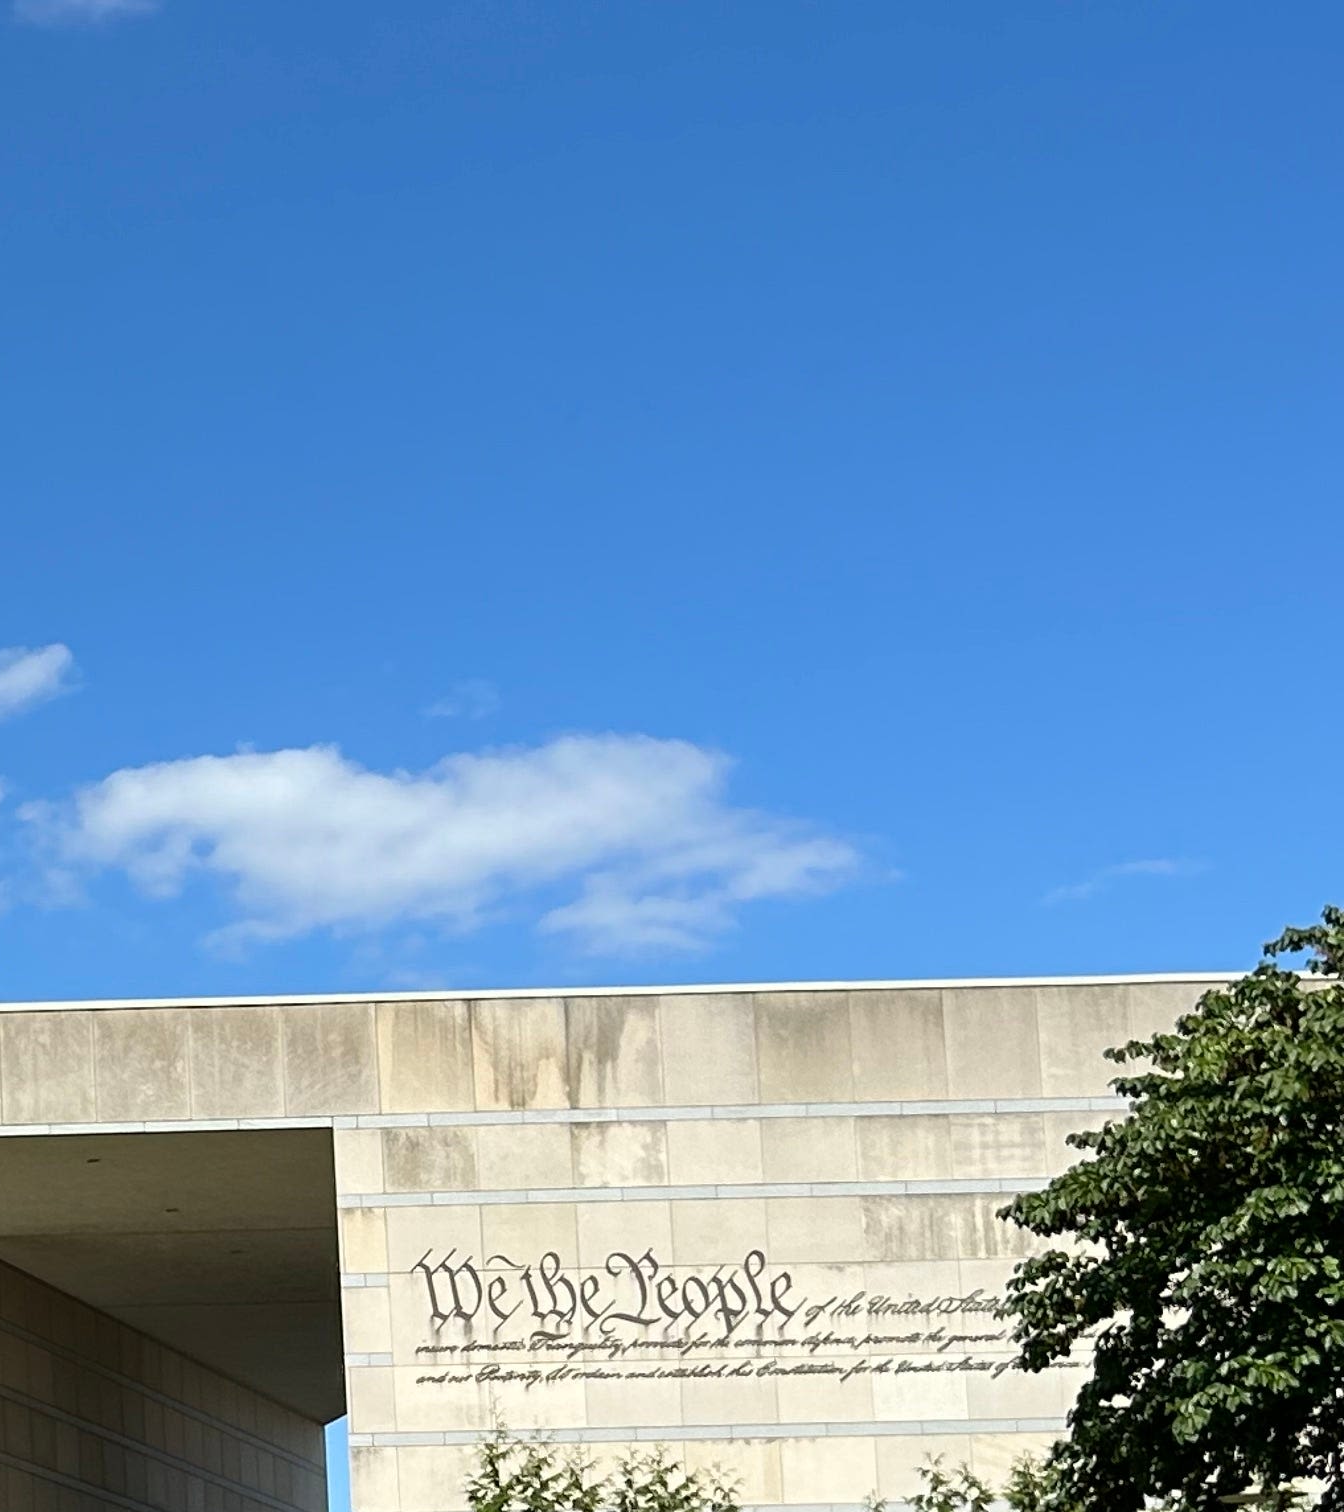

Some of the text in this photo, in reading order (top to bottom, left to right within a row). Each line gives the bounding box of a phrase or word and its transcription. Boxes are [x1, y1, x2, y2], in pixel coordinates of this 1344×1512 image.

[411, 1248, 523, 1334] We
[520, 1251, 615, 1331] the
[600, 1248, 807, 1336] People
[804, 1297, 837, 1327] of
[830, 1291, 866, 1317] the
[867, 1294, 942, 1317] United
